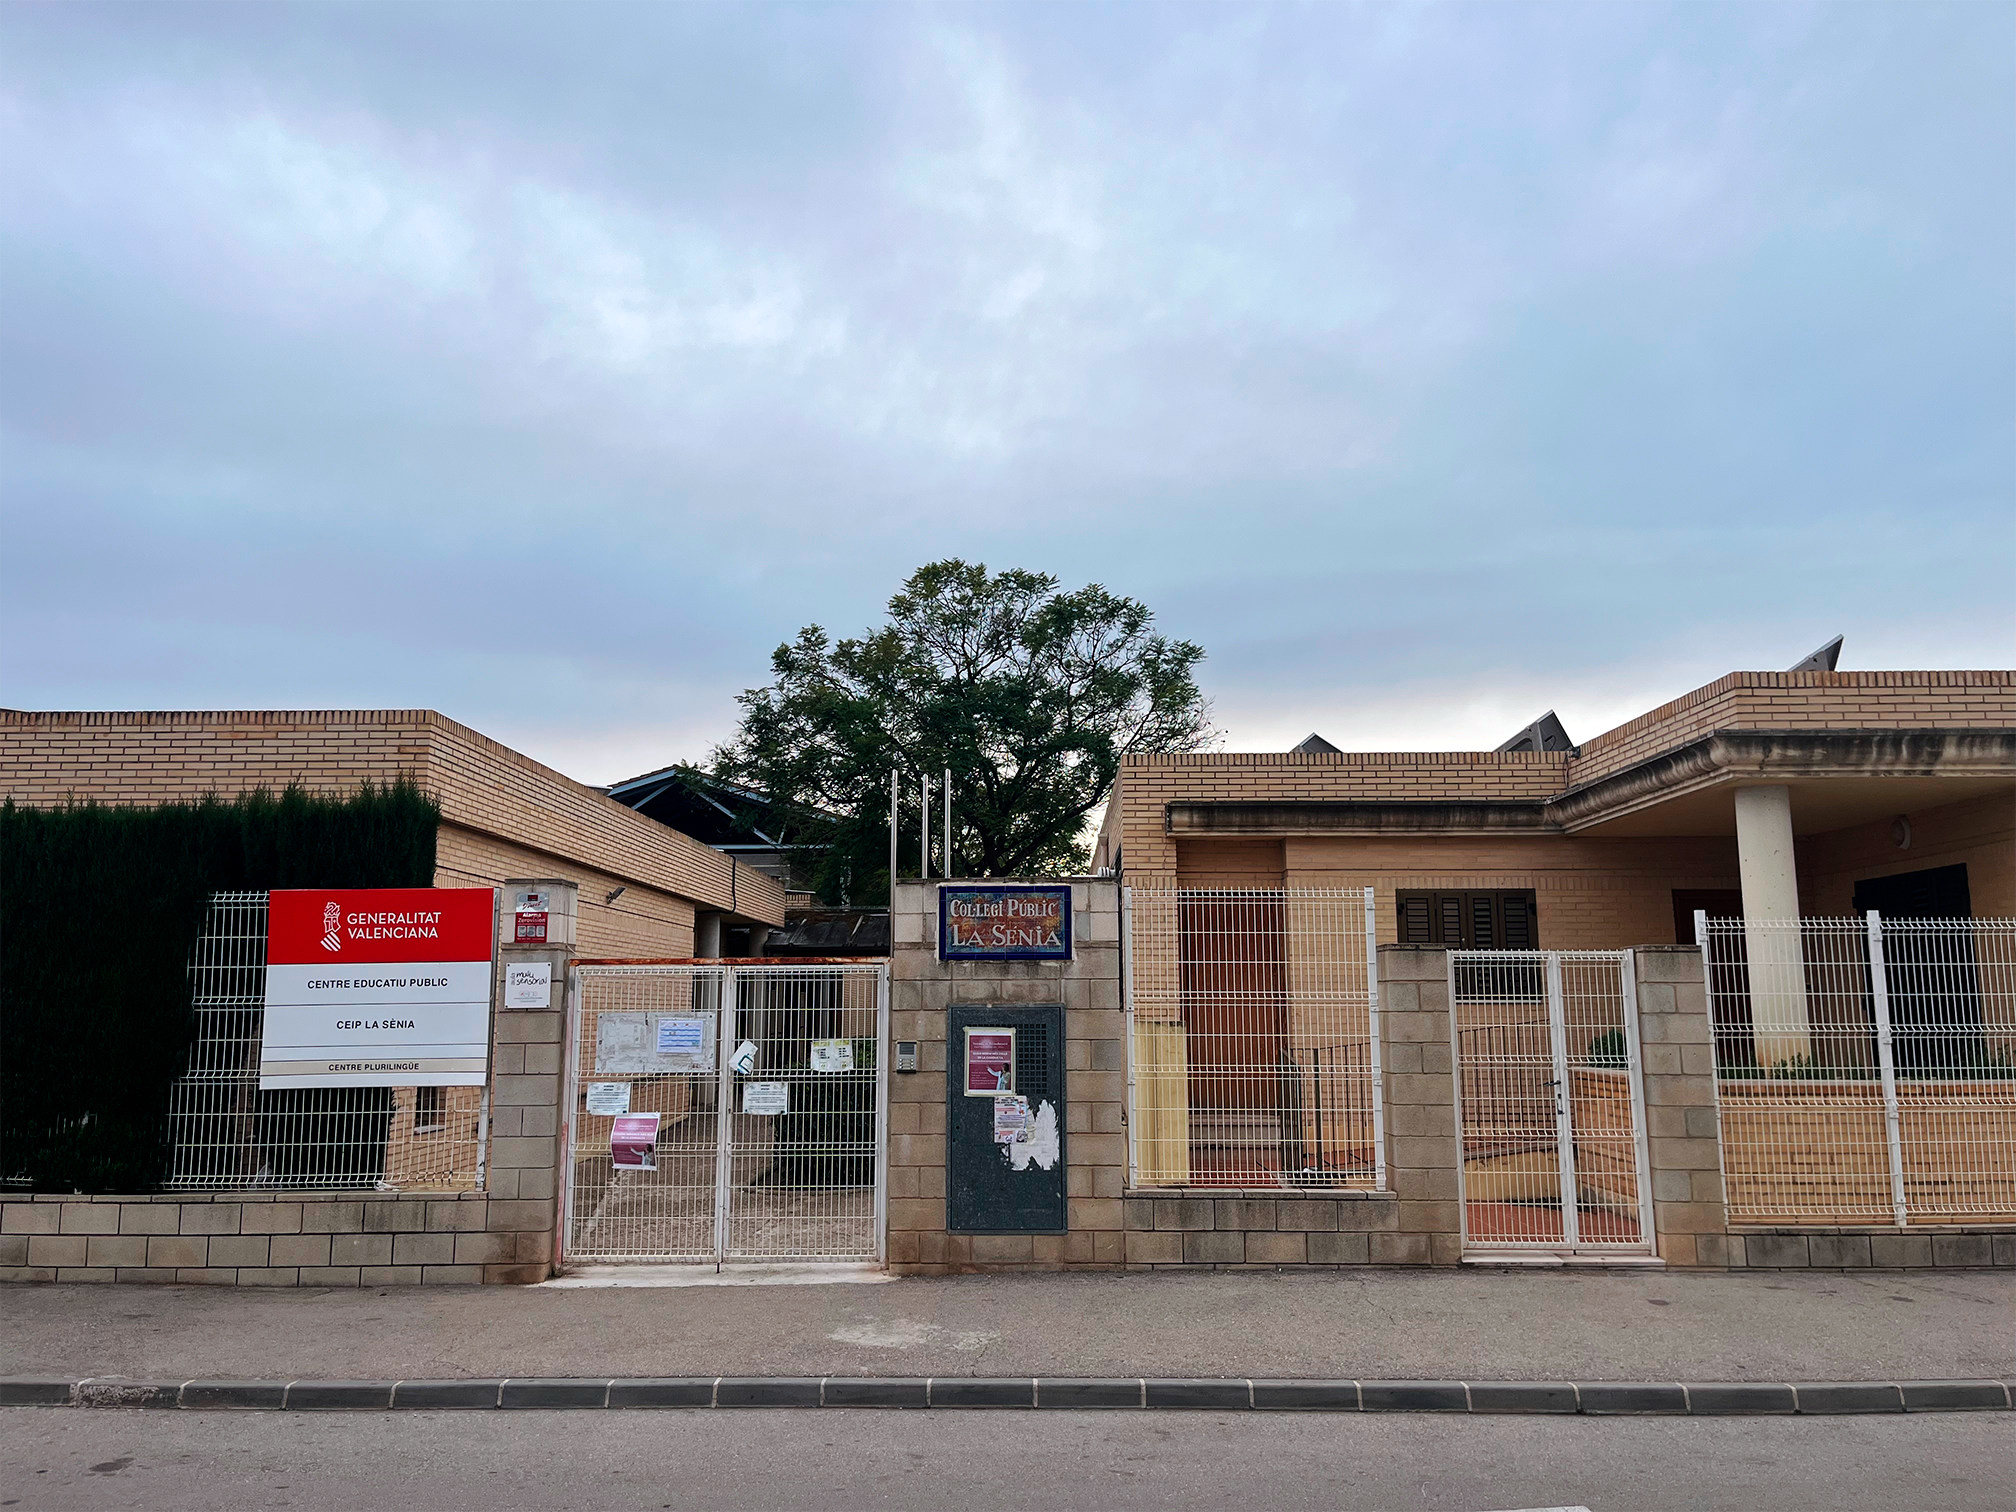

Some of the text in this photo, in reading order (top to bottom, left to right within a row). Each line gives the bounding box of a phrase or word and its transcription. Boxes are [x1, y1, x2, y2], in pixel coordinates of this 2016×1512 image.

[347, 911, 442, 925] GENERALITAT
[347, 926, 438, 939] VALENCIANA
[952, 924, 985, 946] LA
[307, 977, 449, 989] CENTRE EDUCATIU PUBLIC
[336, 1018, 415, 1030] CEIP LA SÈNIA
[328, 1062, 420, 1072] CENTRE PLURILINGÜE
